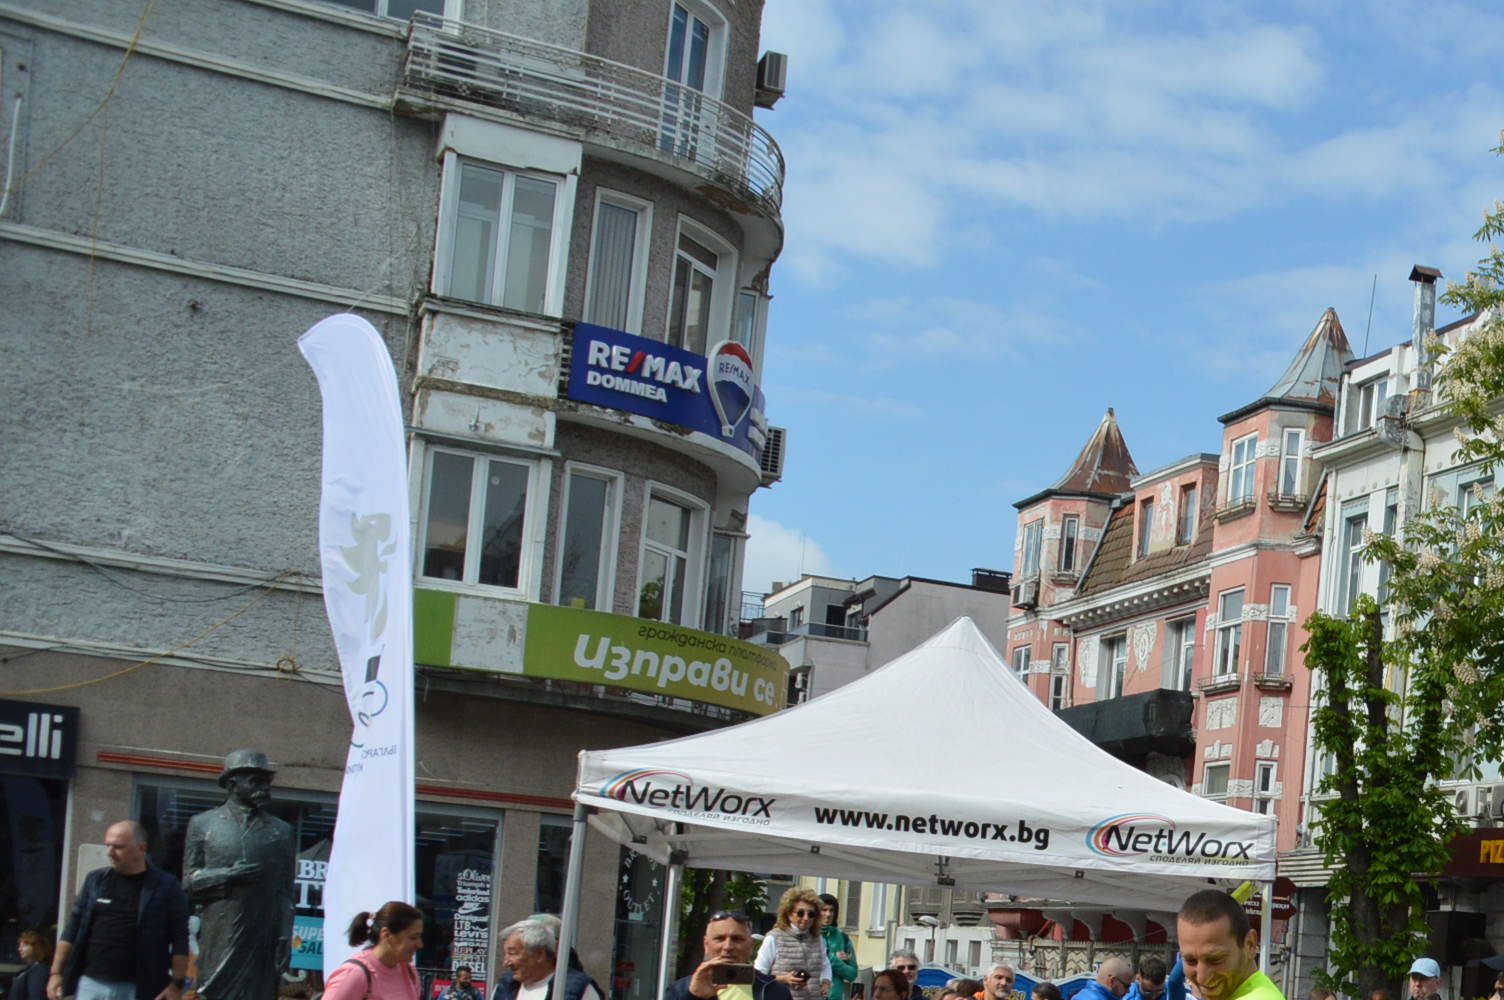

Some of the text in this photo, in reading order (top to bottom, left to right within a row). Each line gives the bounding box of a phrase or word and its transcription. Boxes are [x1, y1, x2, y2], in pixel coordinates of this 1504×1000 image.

[587, 340, 702, 393] RE/MAX
[719, 361, 750, 386] RE/MAX
[587, 370, 668, 403] DOMMEA
[638, 625, 727, 653] гражданска
[623, 780, 776, 818] NetWorx
[815, 807, 1050, 850] www.networx.bg
[1104, 824, 1254, 860] NetWorx
